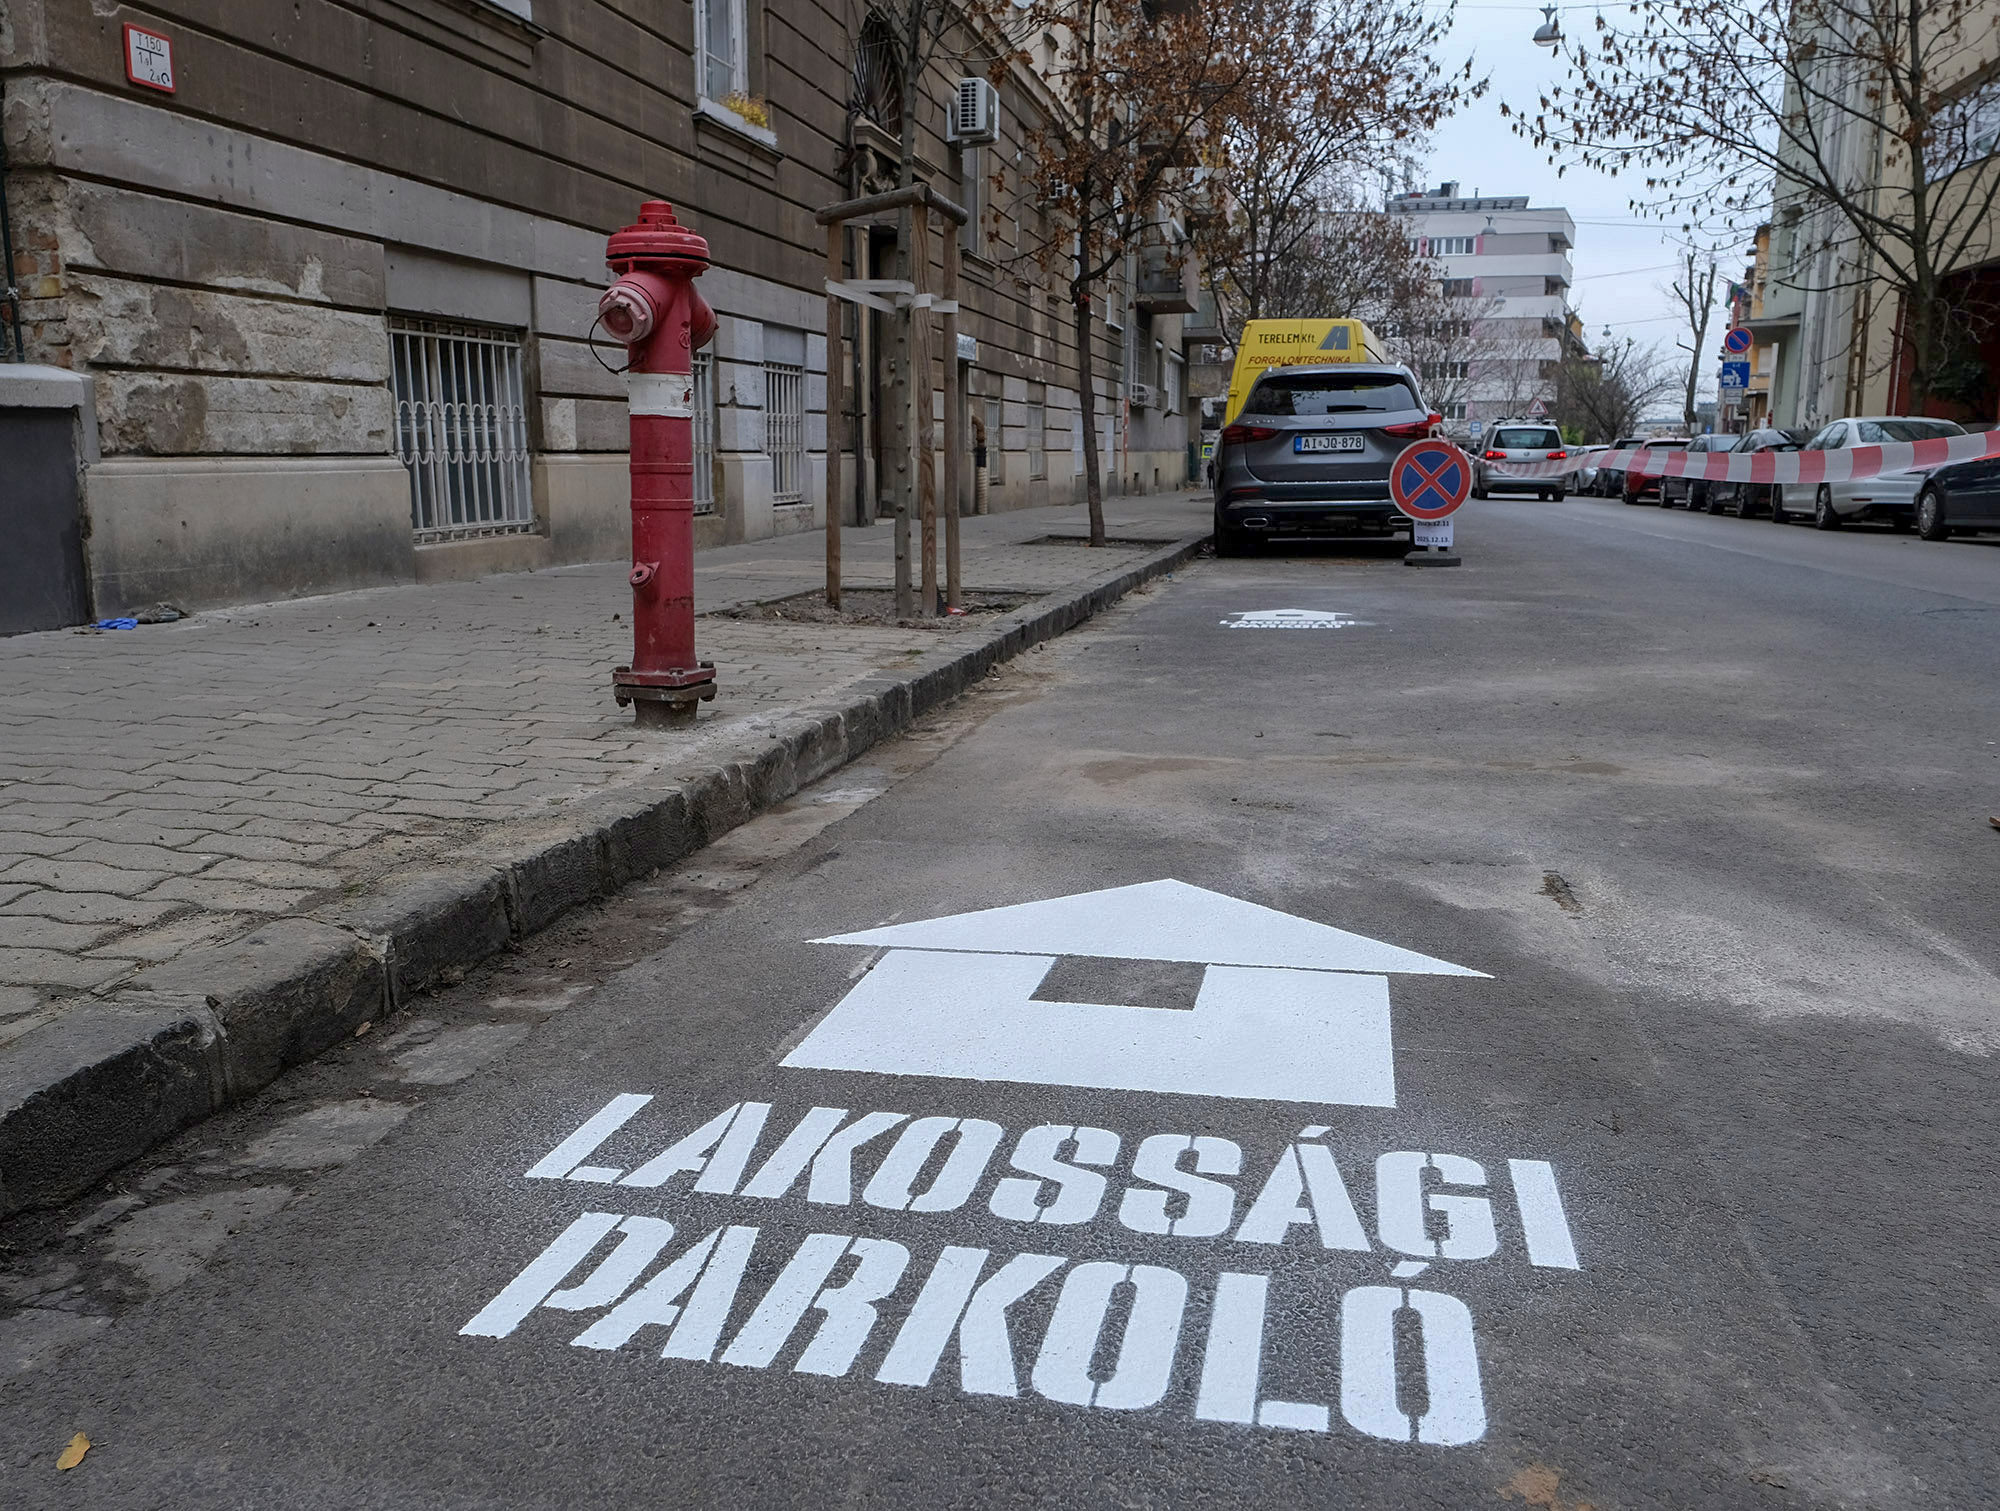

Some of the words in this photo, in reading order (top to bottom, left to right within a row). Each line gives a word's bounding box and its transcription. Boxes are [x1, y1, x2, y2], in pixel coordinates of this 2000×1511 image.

[1248, 355, 1351, 365] FORGALOMTECHNIKA
[1259, 333, 1299, 344] TERELEM
[1302, 333, 1316, 344] Kft.
[524, 1093, 1583, 1271] LAKOSSÁGI
[458, 1211, 1489, 1447] PARKOLÓ
